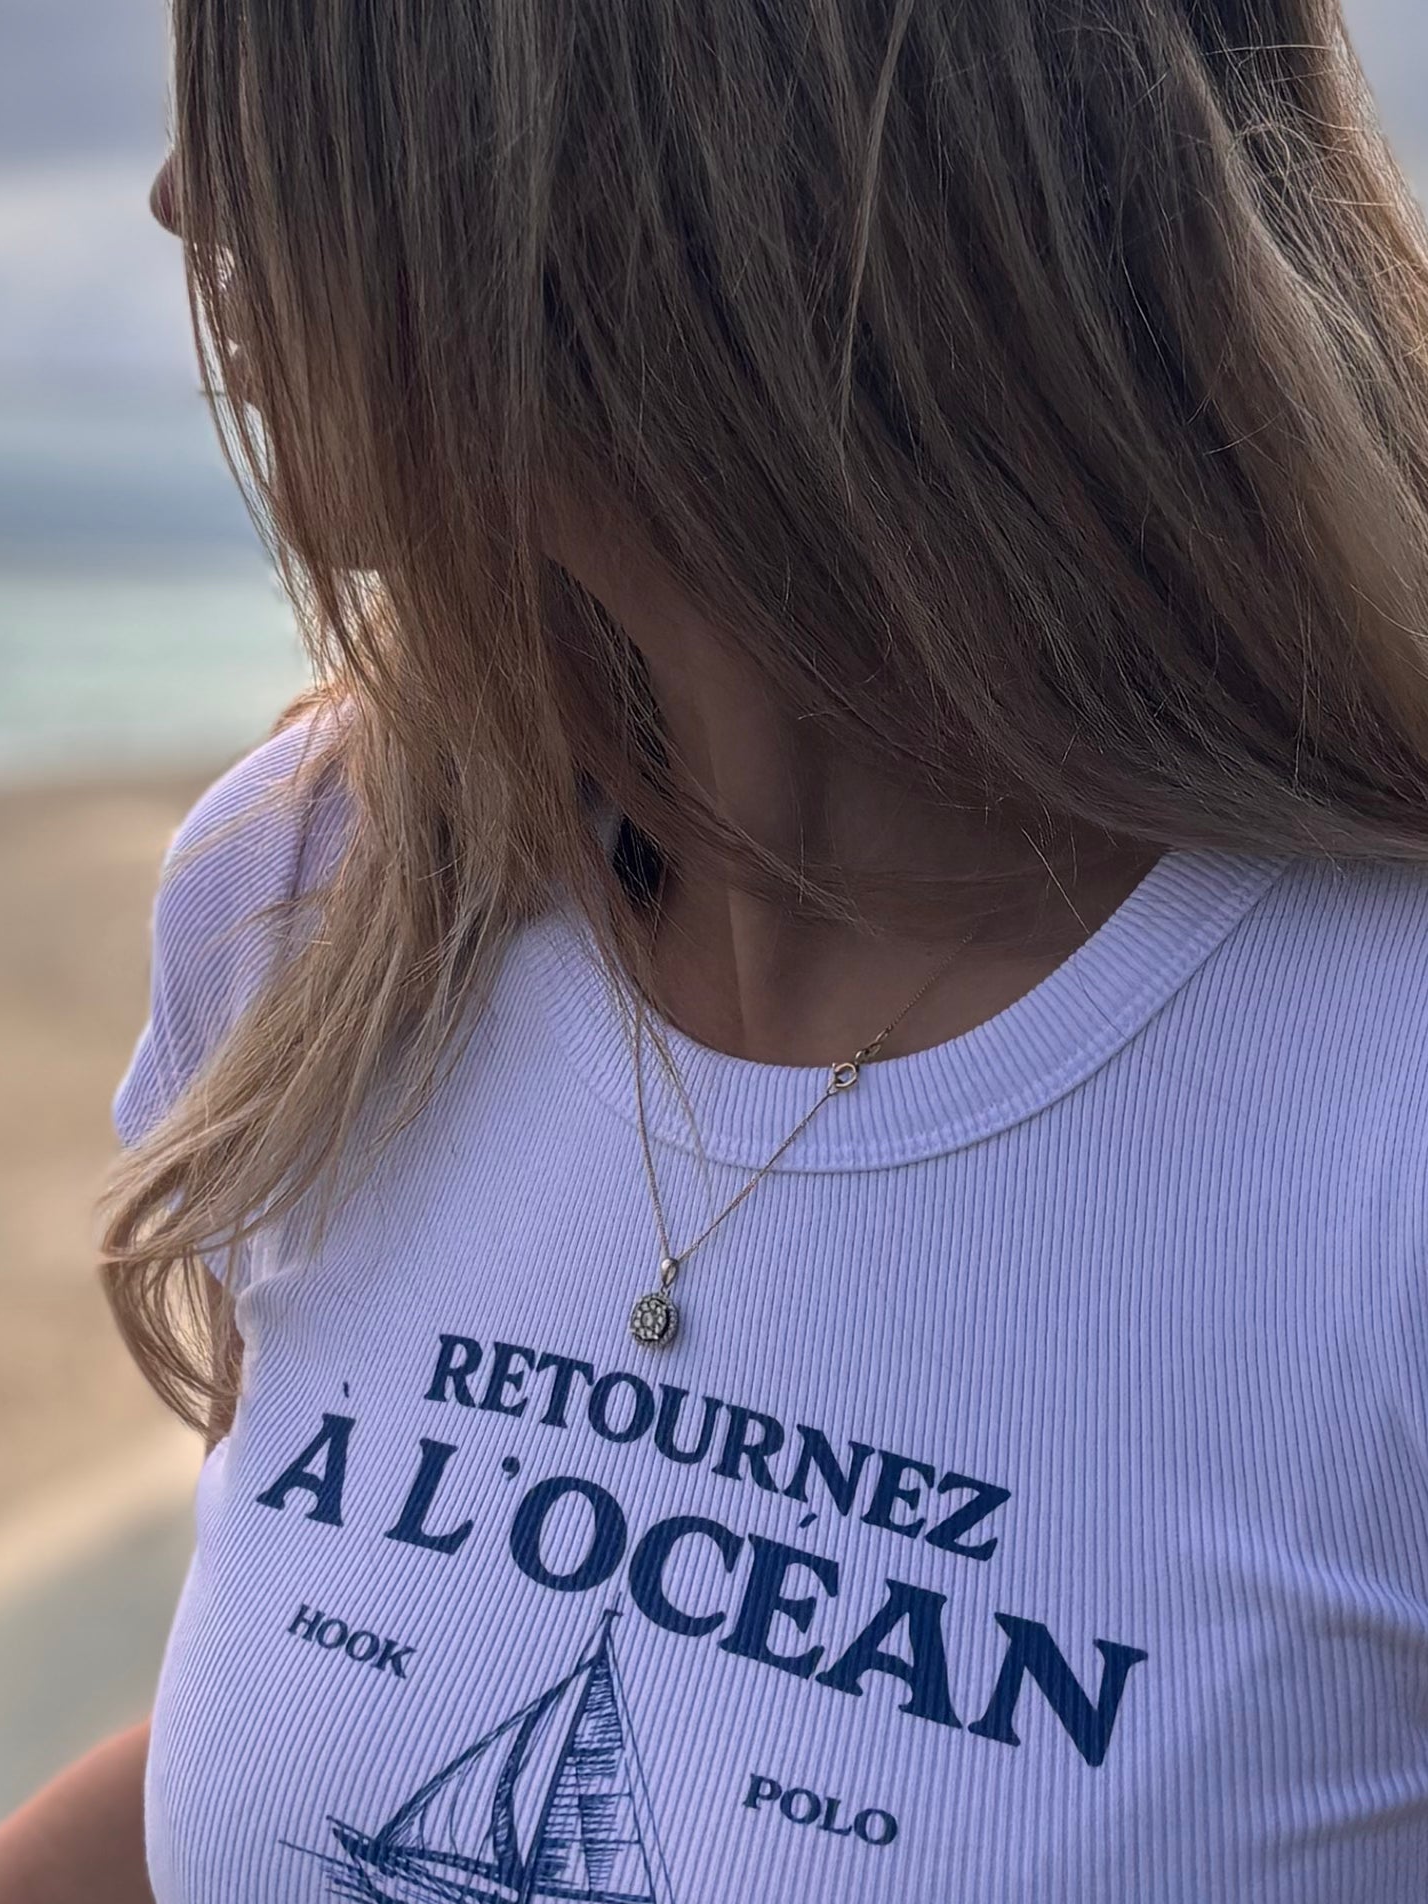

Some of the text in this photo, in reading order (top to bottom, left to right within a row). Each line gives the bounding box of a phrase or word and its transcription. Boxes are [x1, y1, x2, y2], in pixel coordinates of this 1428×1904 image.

[256, 1381, 356, 1527] À
[424, 1333, 1013, 1561] RETOURNEZ
[286, 1604, 418, 1680] HOOK
[743, 1773, 898, 1847] POLO
